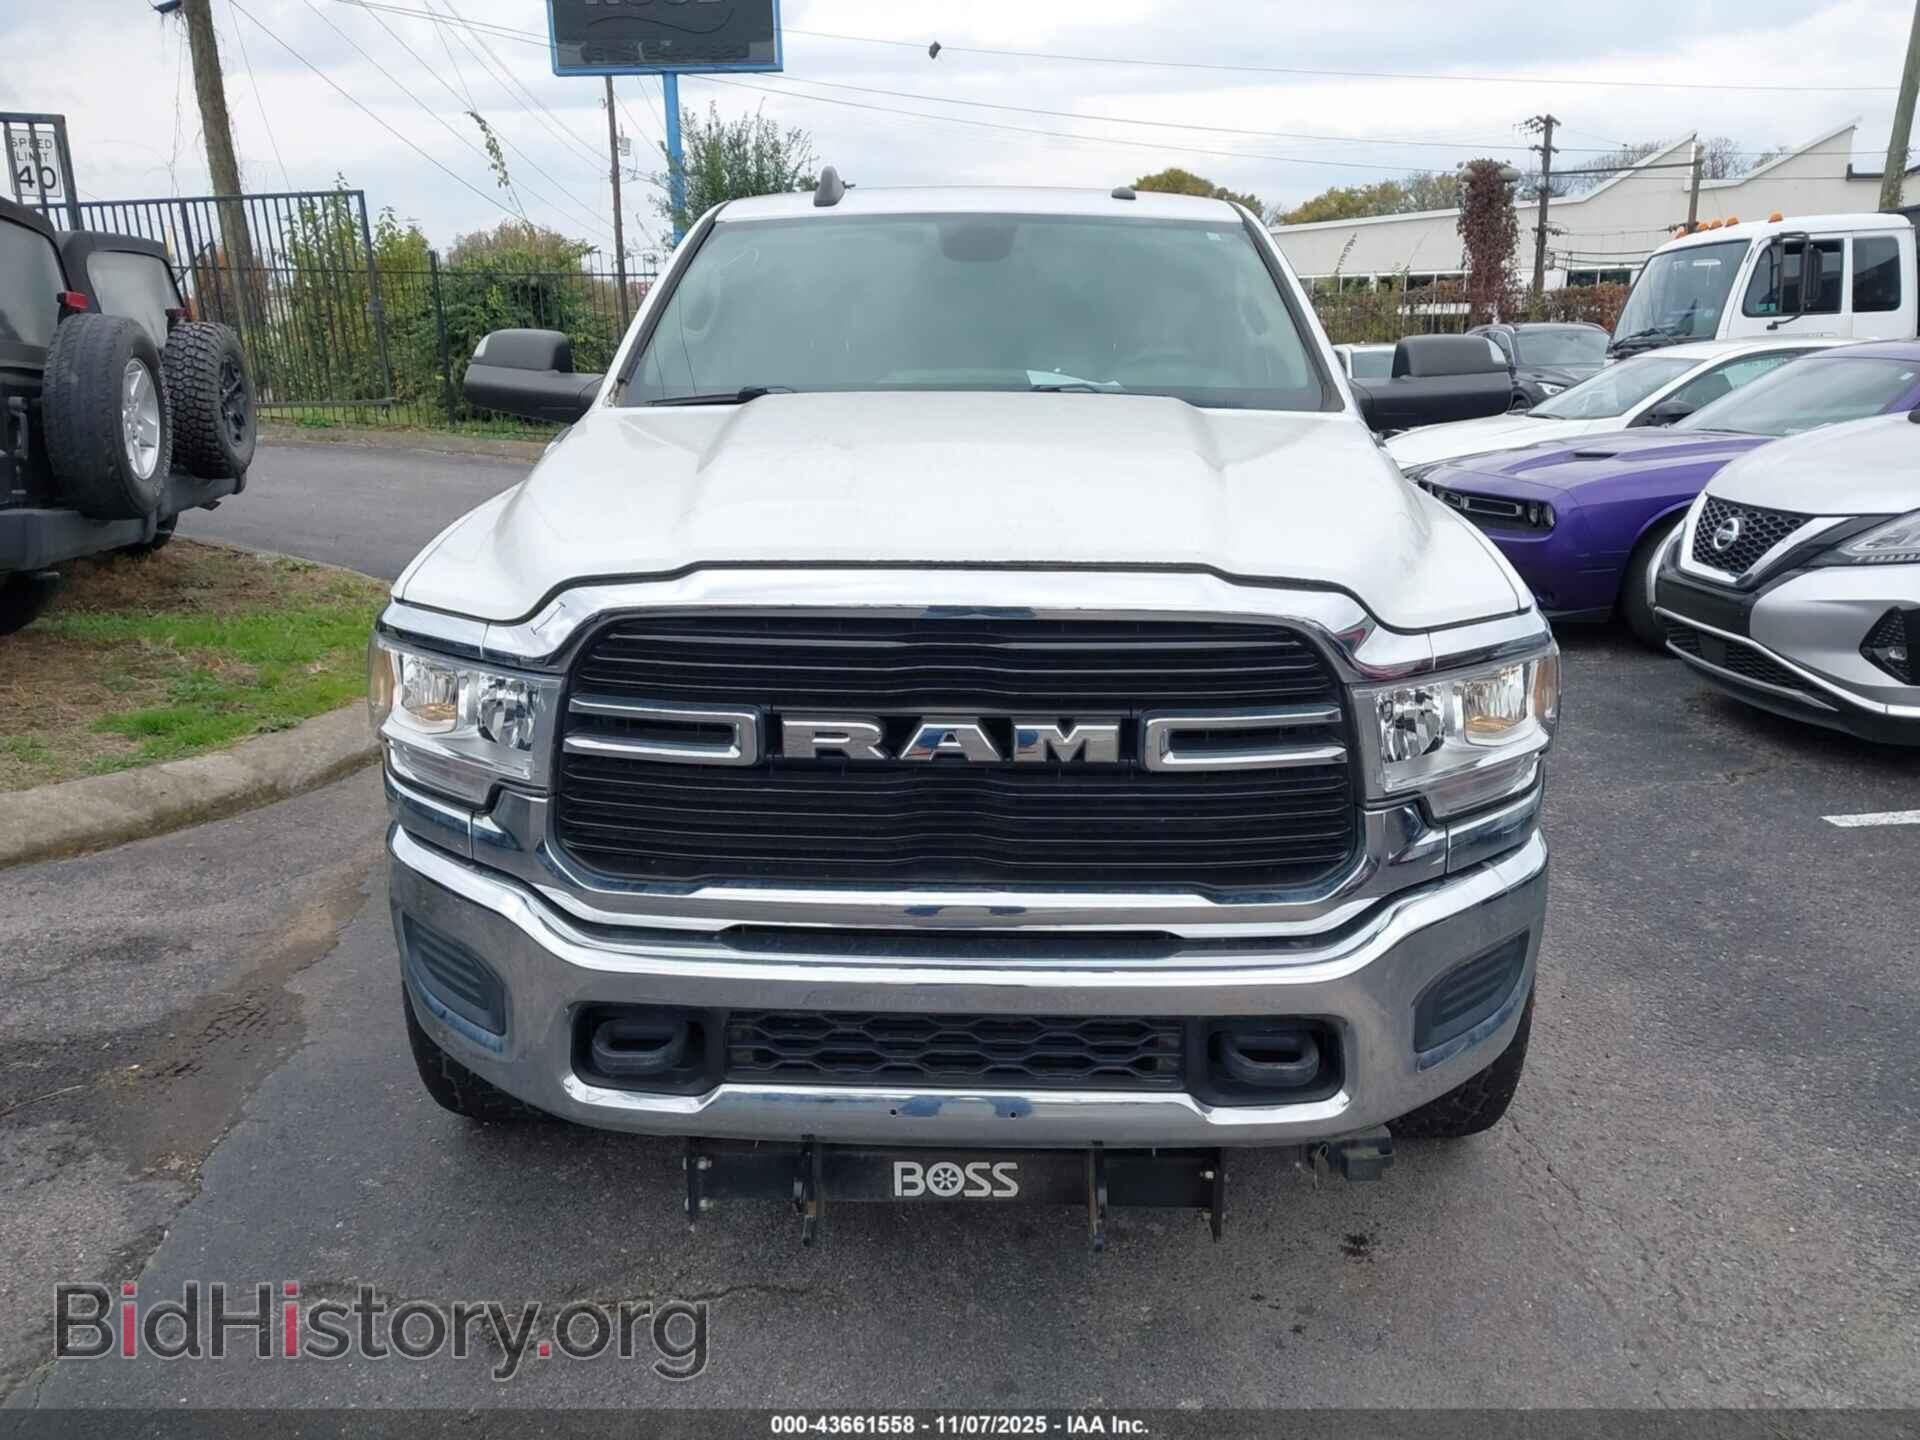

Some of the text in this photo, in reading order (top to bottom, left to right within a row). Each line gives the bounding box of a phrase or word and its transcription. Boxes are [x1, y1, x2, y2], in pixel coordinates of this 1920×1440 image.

[16, 151, 49, 162] LIMT
[18, 165, 56, 189] 40
[781, 715, 1121, 763] RAM
[893, 1161, 1019, 1197] BOSS
